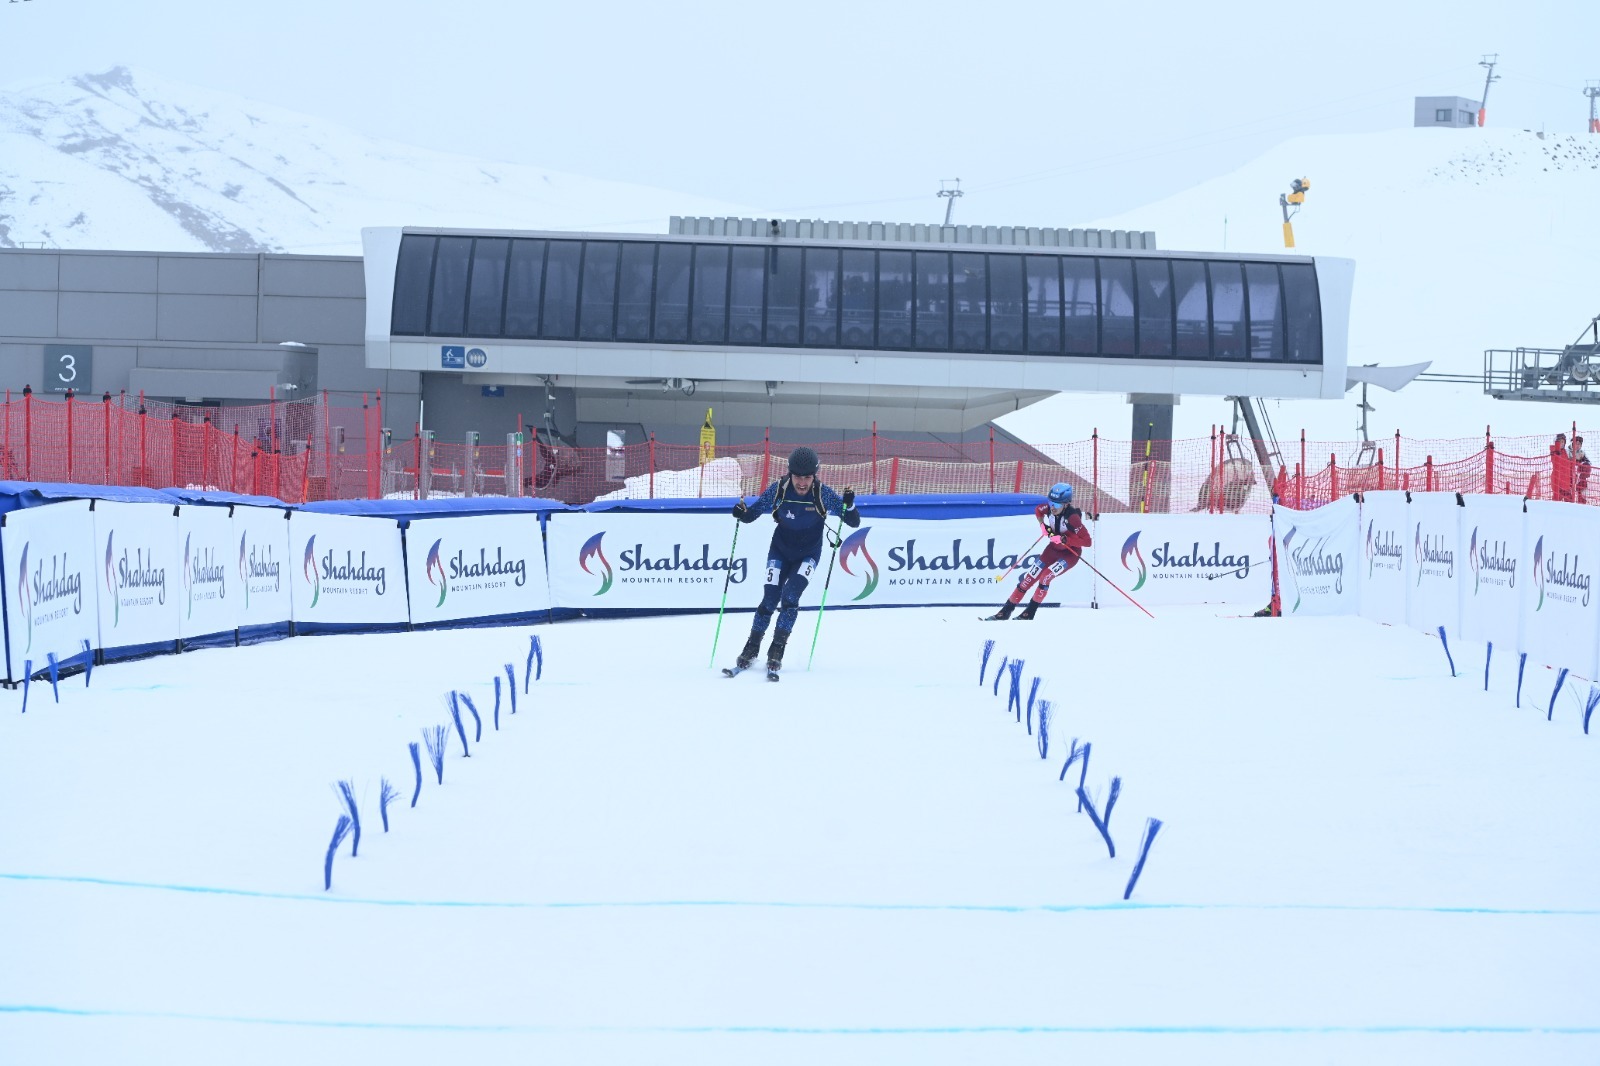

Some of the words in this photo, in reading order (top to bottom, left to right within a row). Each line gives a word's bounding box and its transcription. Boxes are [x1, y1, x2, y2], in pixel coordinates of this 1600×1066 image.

[58, 354, 76, 382] 3
[249, 544, 280, 593] Shahdag
[449, 546, 527, 587] Shahdag
[619, 543, 748, 584] Shahdag
[804, 565, 813, 577] 5
[1051, 562, 1063, 574] 13
[1151, 542, 1250, 580] Shahdag
[1292, 535, 1344, 595] Shahdag
[1374, 530, 1403, 571] Shahdag
[1422, 534, 1454, 579] Shahdag
[1480, 539, 1517, 589] Shahdag
[33, 551, 82, 615] Shahdag
[118, 547, 166, 606] Shahdag
[192, 546, 225, 599] Shahdag
[321, 548, 386, 596] Shahdag
[451, 583, 482, 593] MOUNTAIN
[484, 581, 506, 590] RESORT
[766, 568, 774, 582] 5
[889, 578, 952, 586] MOUNTAIN
[1546, 550, 1591, 607] Shahdag
